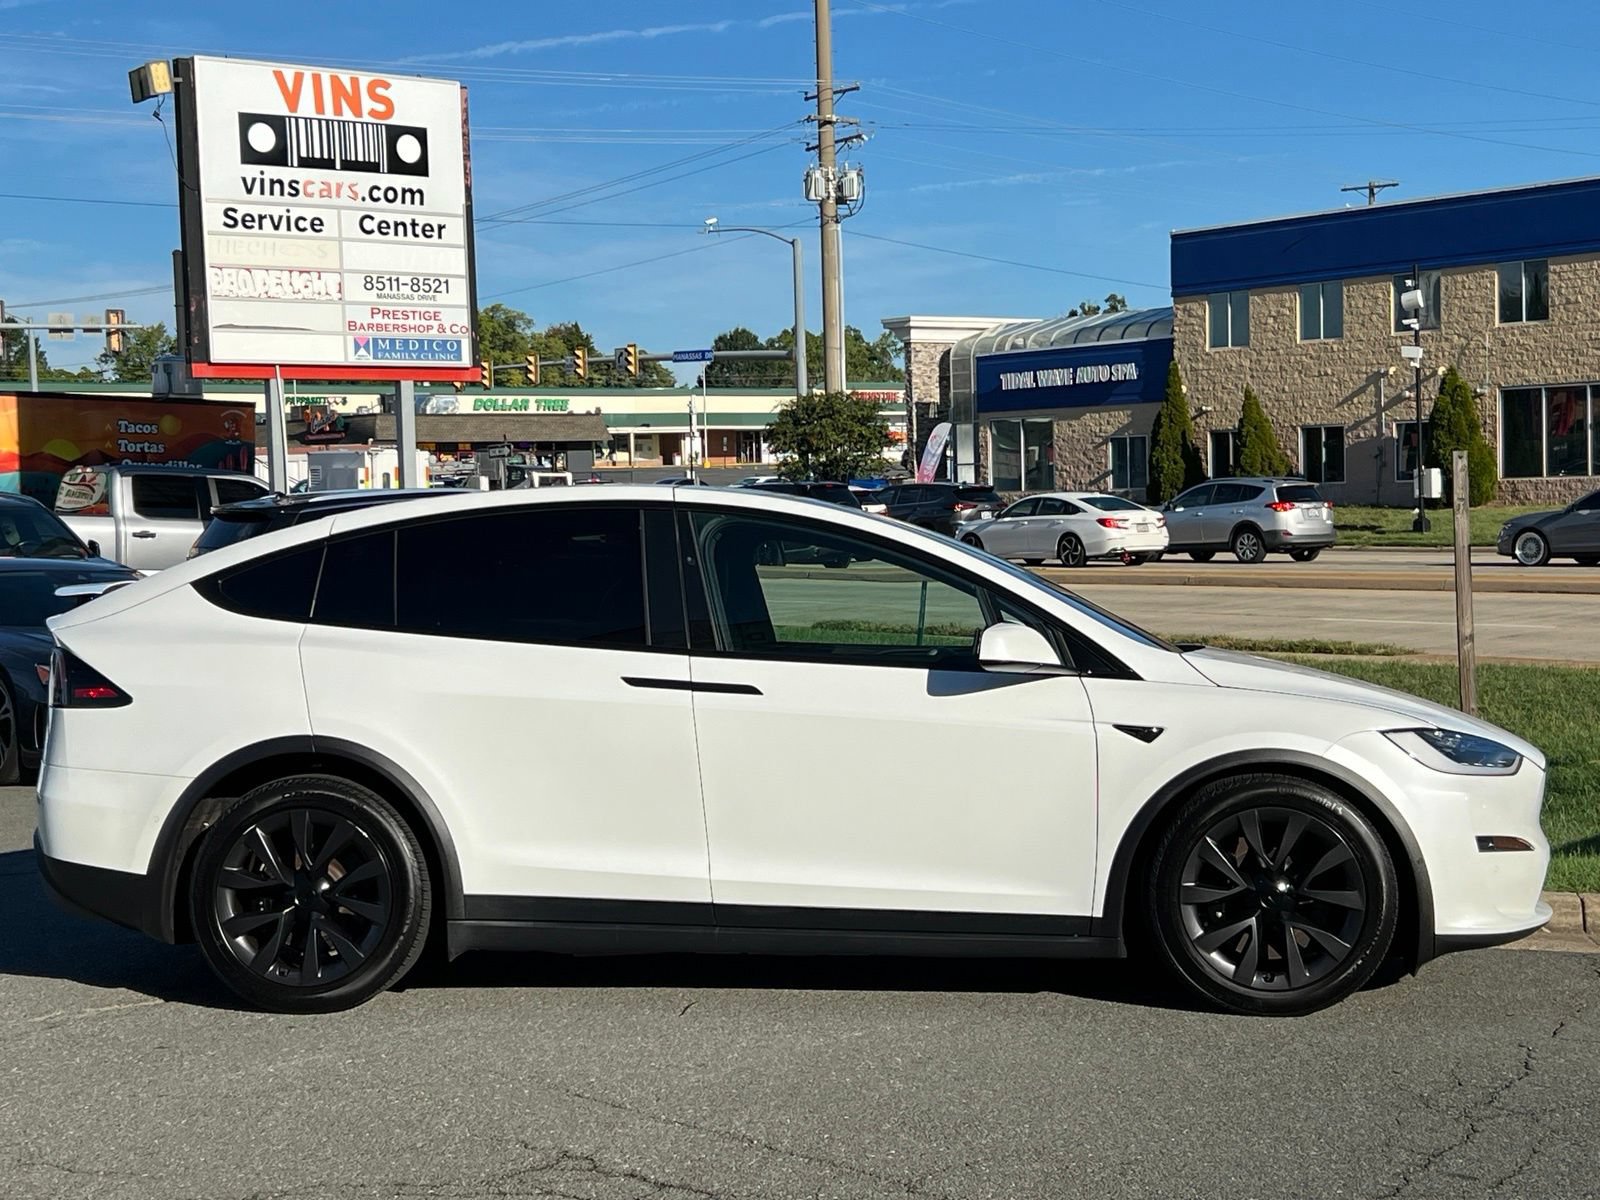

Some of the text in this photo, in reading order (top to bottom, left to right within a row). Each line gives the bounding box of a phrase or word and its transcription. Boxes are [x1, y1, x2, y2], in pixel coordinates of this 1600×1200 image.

[272, 70, 395, 121] VINS
[241, 170, 425, 206] vinscars.com
[222, 207, 446, 240] Service Center
[363, 275, 449, 294] 8511-8521
[376, 293, 438, 302] MANASSAS DRIVE
[370, 307, 442, 321] PRESTIGE
[347, 320, 434, 333] BARBERSHOP
[437, 323, 447, 334] &
[377, 339, 458, 351] MEDICO
[377, 352, 422, 360] FAMILY
[423, 352, 459, 361] CLINIC
[673, 352, 702, 360] MANASSAS
[1000, 362, 1138, 390] TIDAL WAVE AUTO SPA
[473, 398, 570, 412] DOLLAR TREE
[117, 420, 159, 434] Tacos
[117, 439, 165, 453] Tortas
